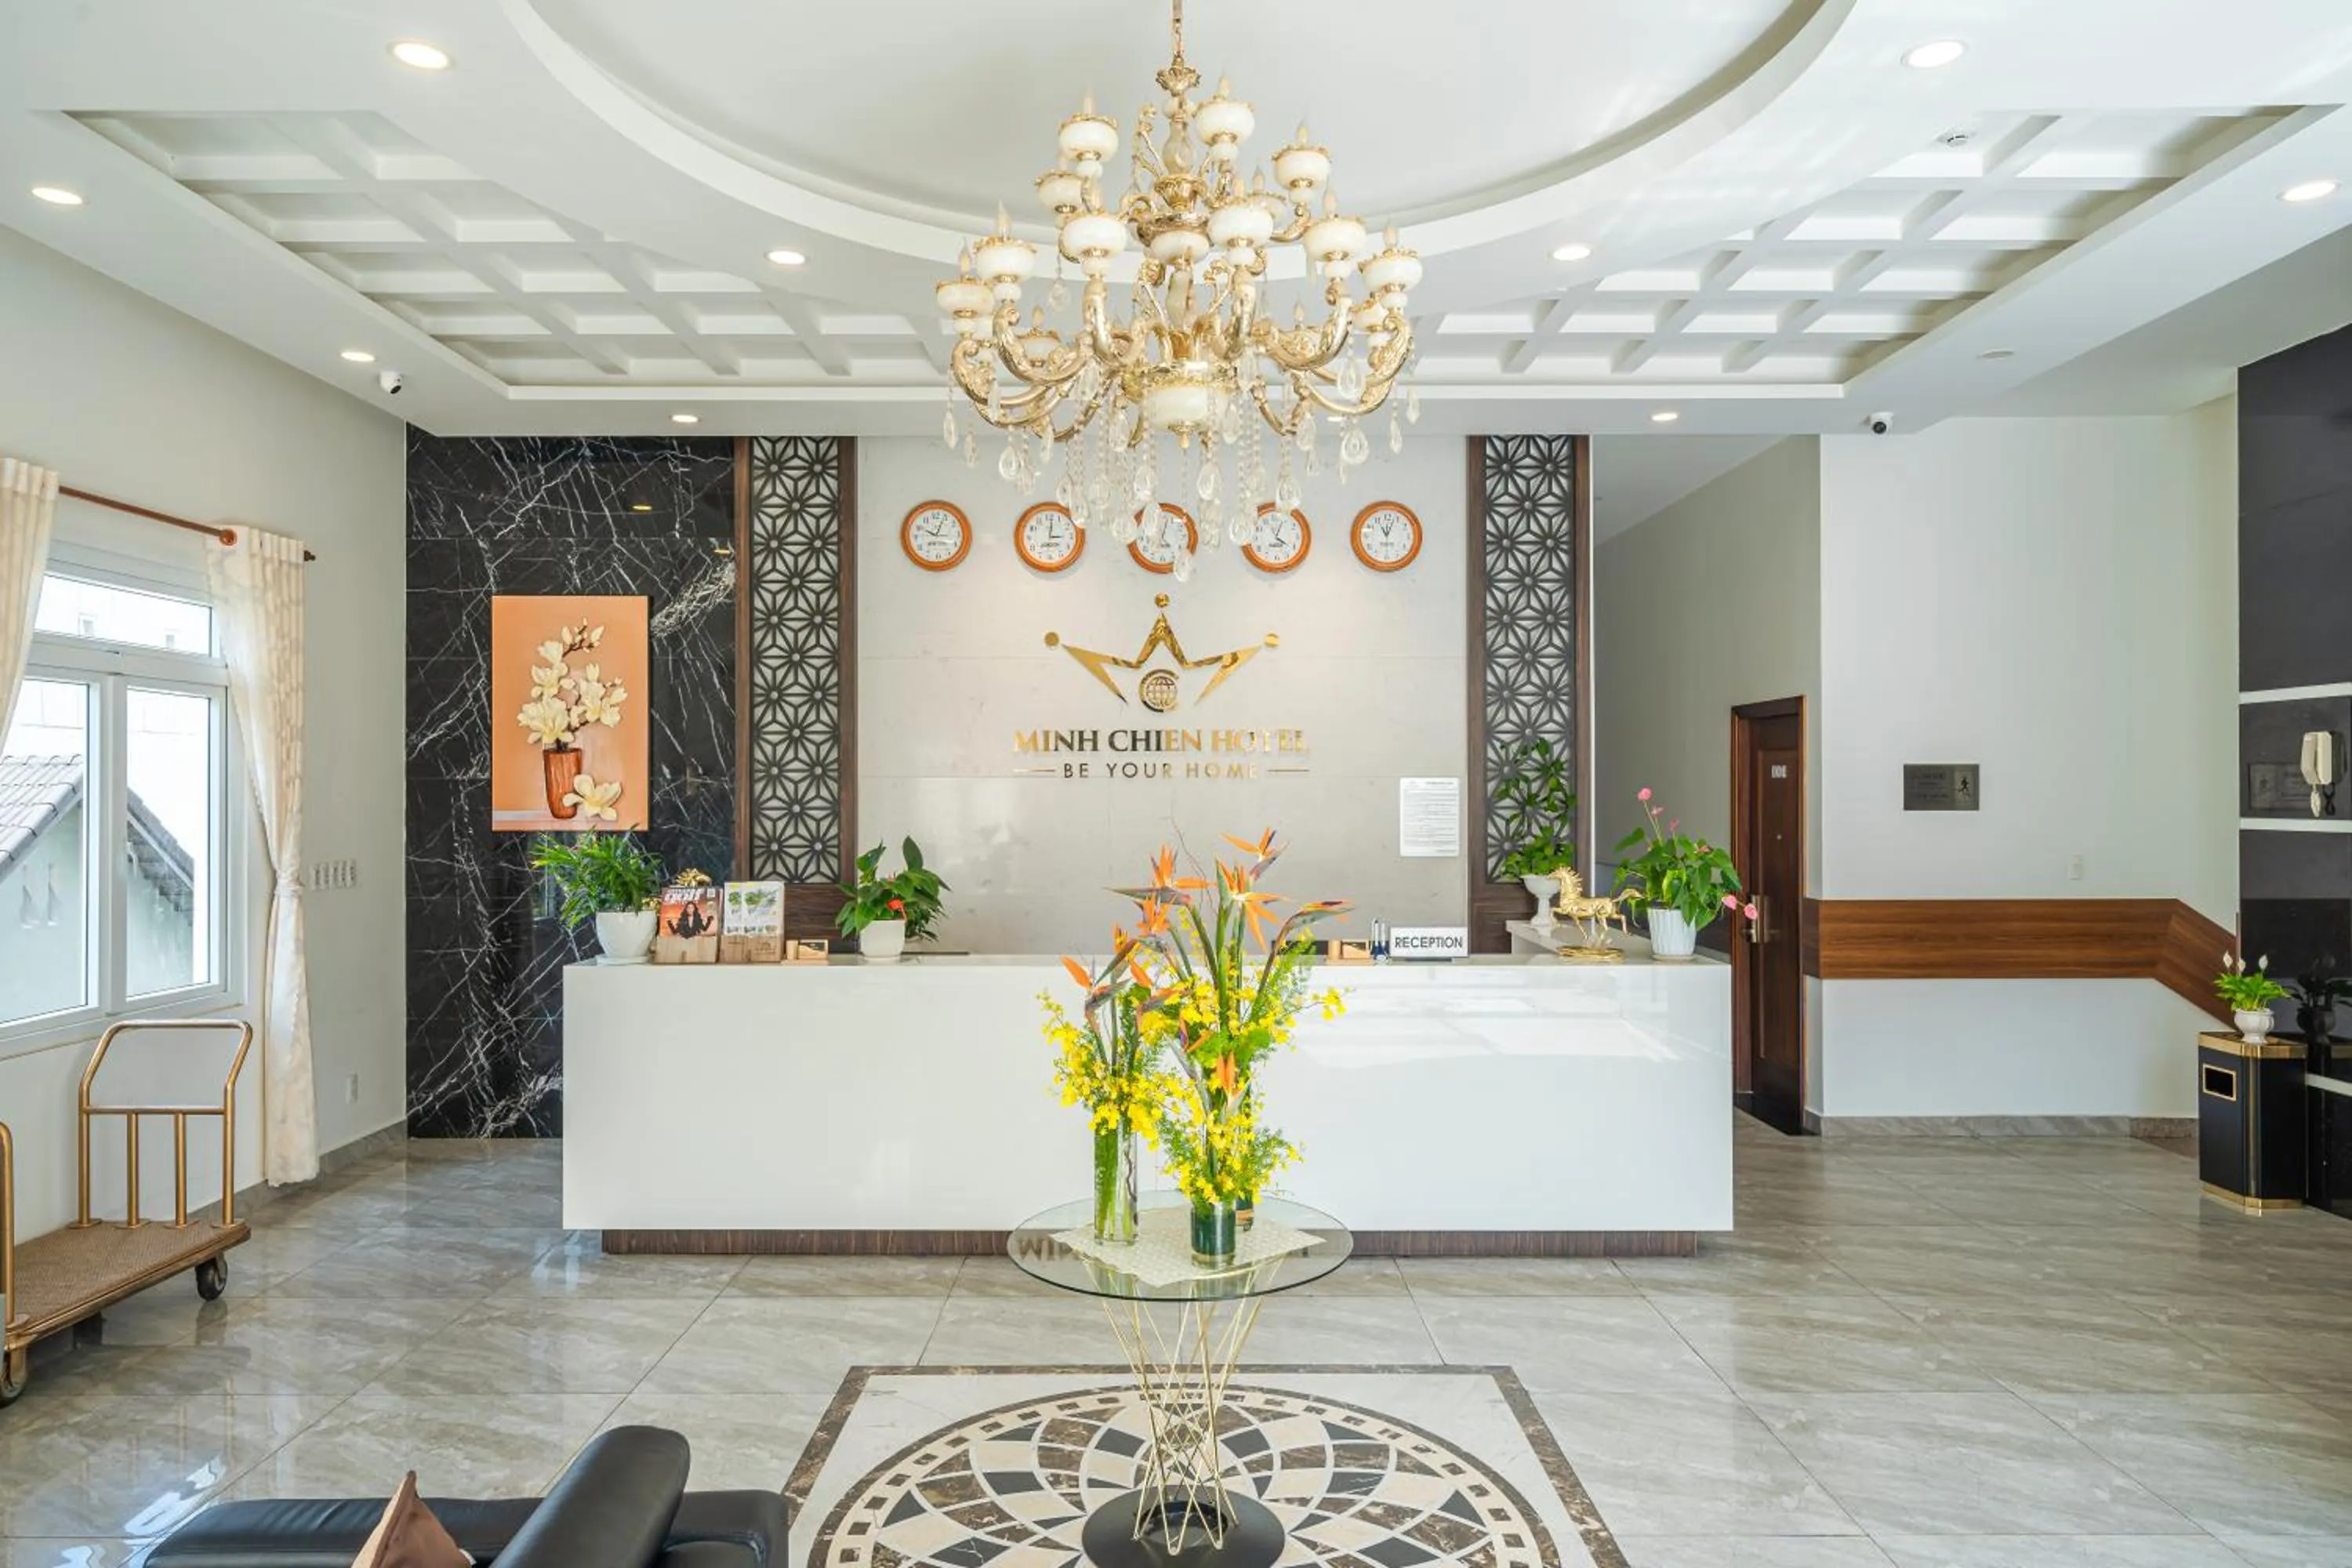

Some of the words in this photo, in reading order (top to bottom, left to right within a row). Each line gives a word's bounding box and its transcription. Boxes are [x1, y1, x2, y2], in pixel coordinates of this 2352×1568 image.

[1013, 729, 1099, 753] MINH
[1108, 729, 1202, 753] CHIEN
[1211, 729, 1310, 753] HOTEL
[1064, 763, 1089, 779] BE
[1106, 762, 1173, 779] YOUR
[1186, 762, 1258, 779] HOME
[1395, 936, 1463, 949] RECEPTION
